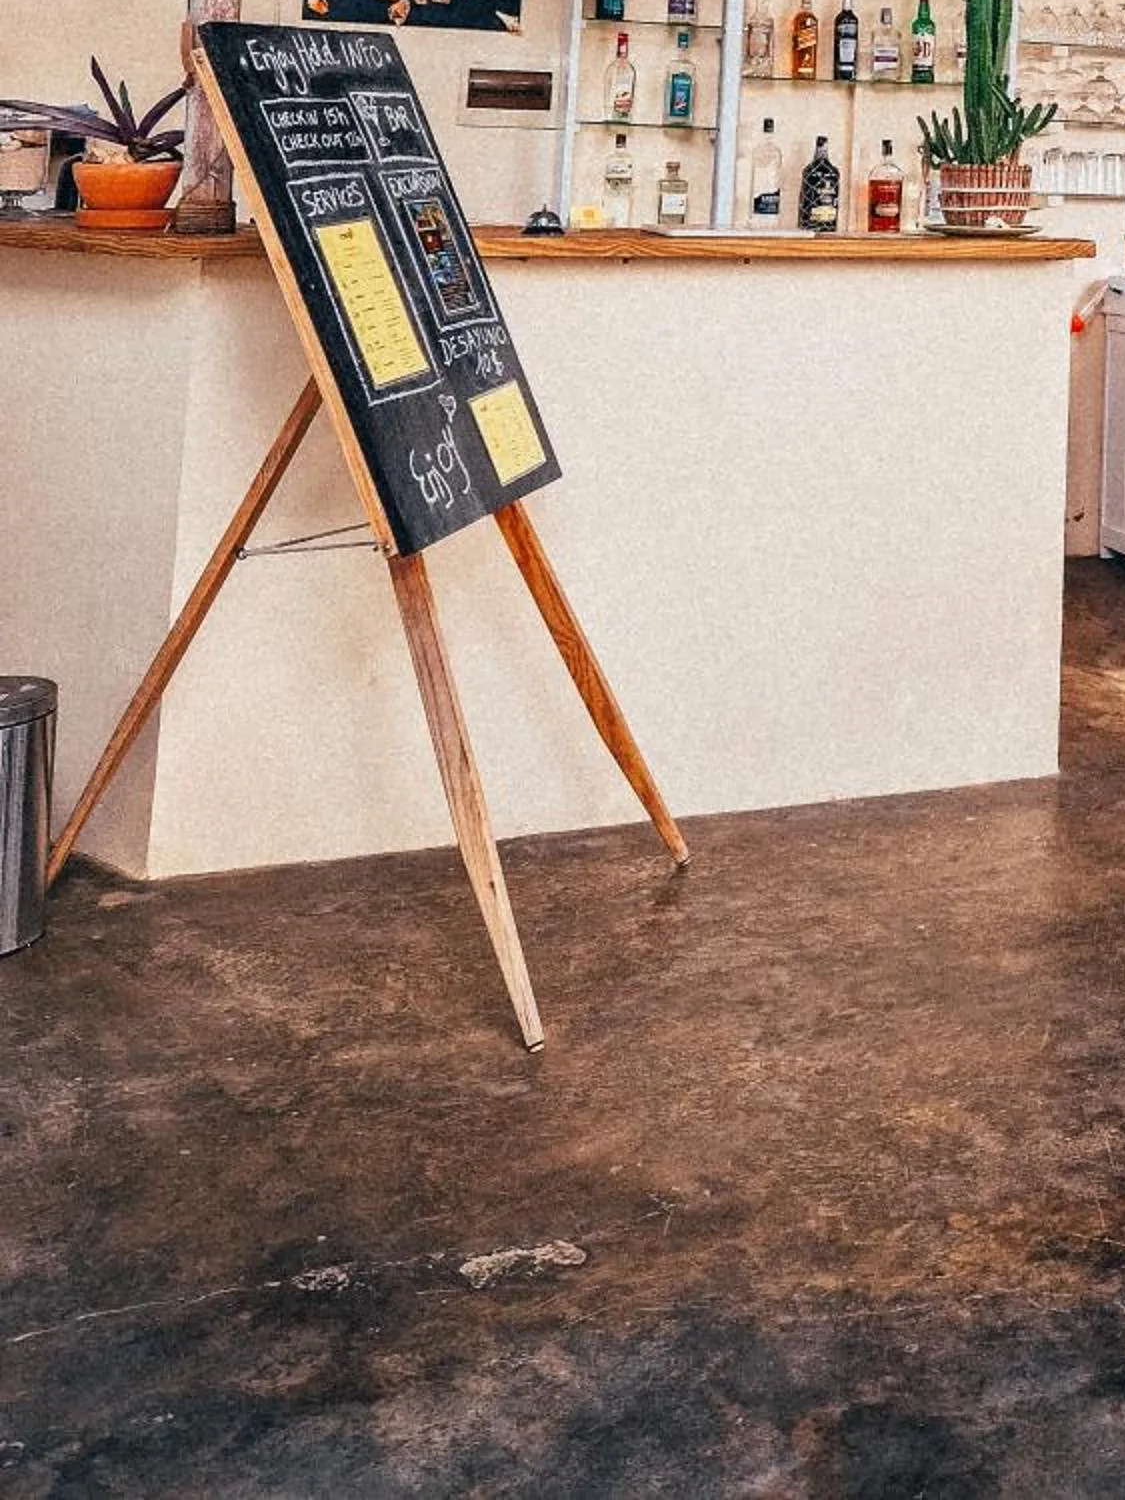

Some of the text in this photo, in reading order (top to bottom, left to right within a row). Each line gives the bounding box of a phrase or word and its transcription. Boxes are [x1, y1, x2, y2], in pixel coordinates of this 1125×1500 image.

[245, 34, 309, 94] Enjoy
[339, 37, 384, 69] INFO
[384, 105, 421, 133] BAR
[282, 132, 321, 152] CHECK
[321, 132, 343, 148] OUT
[301, 182, 364, 217] SERVICES
[438, 325, 508, 367] DESAYUNO
[409, 426, 471, 510] Enjoy
